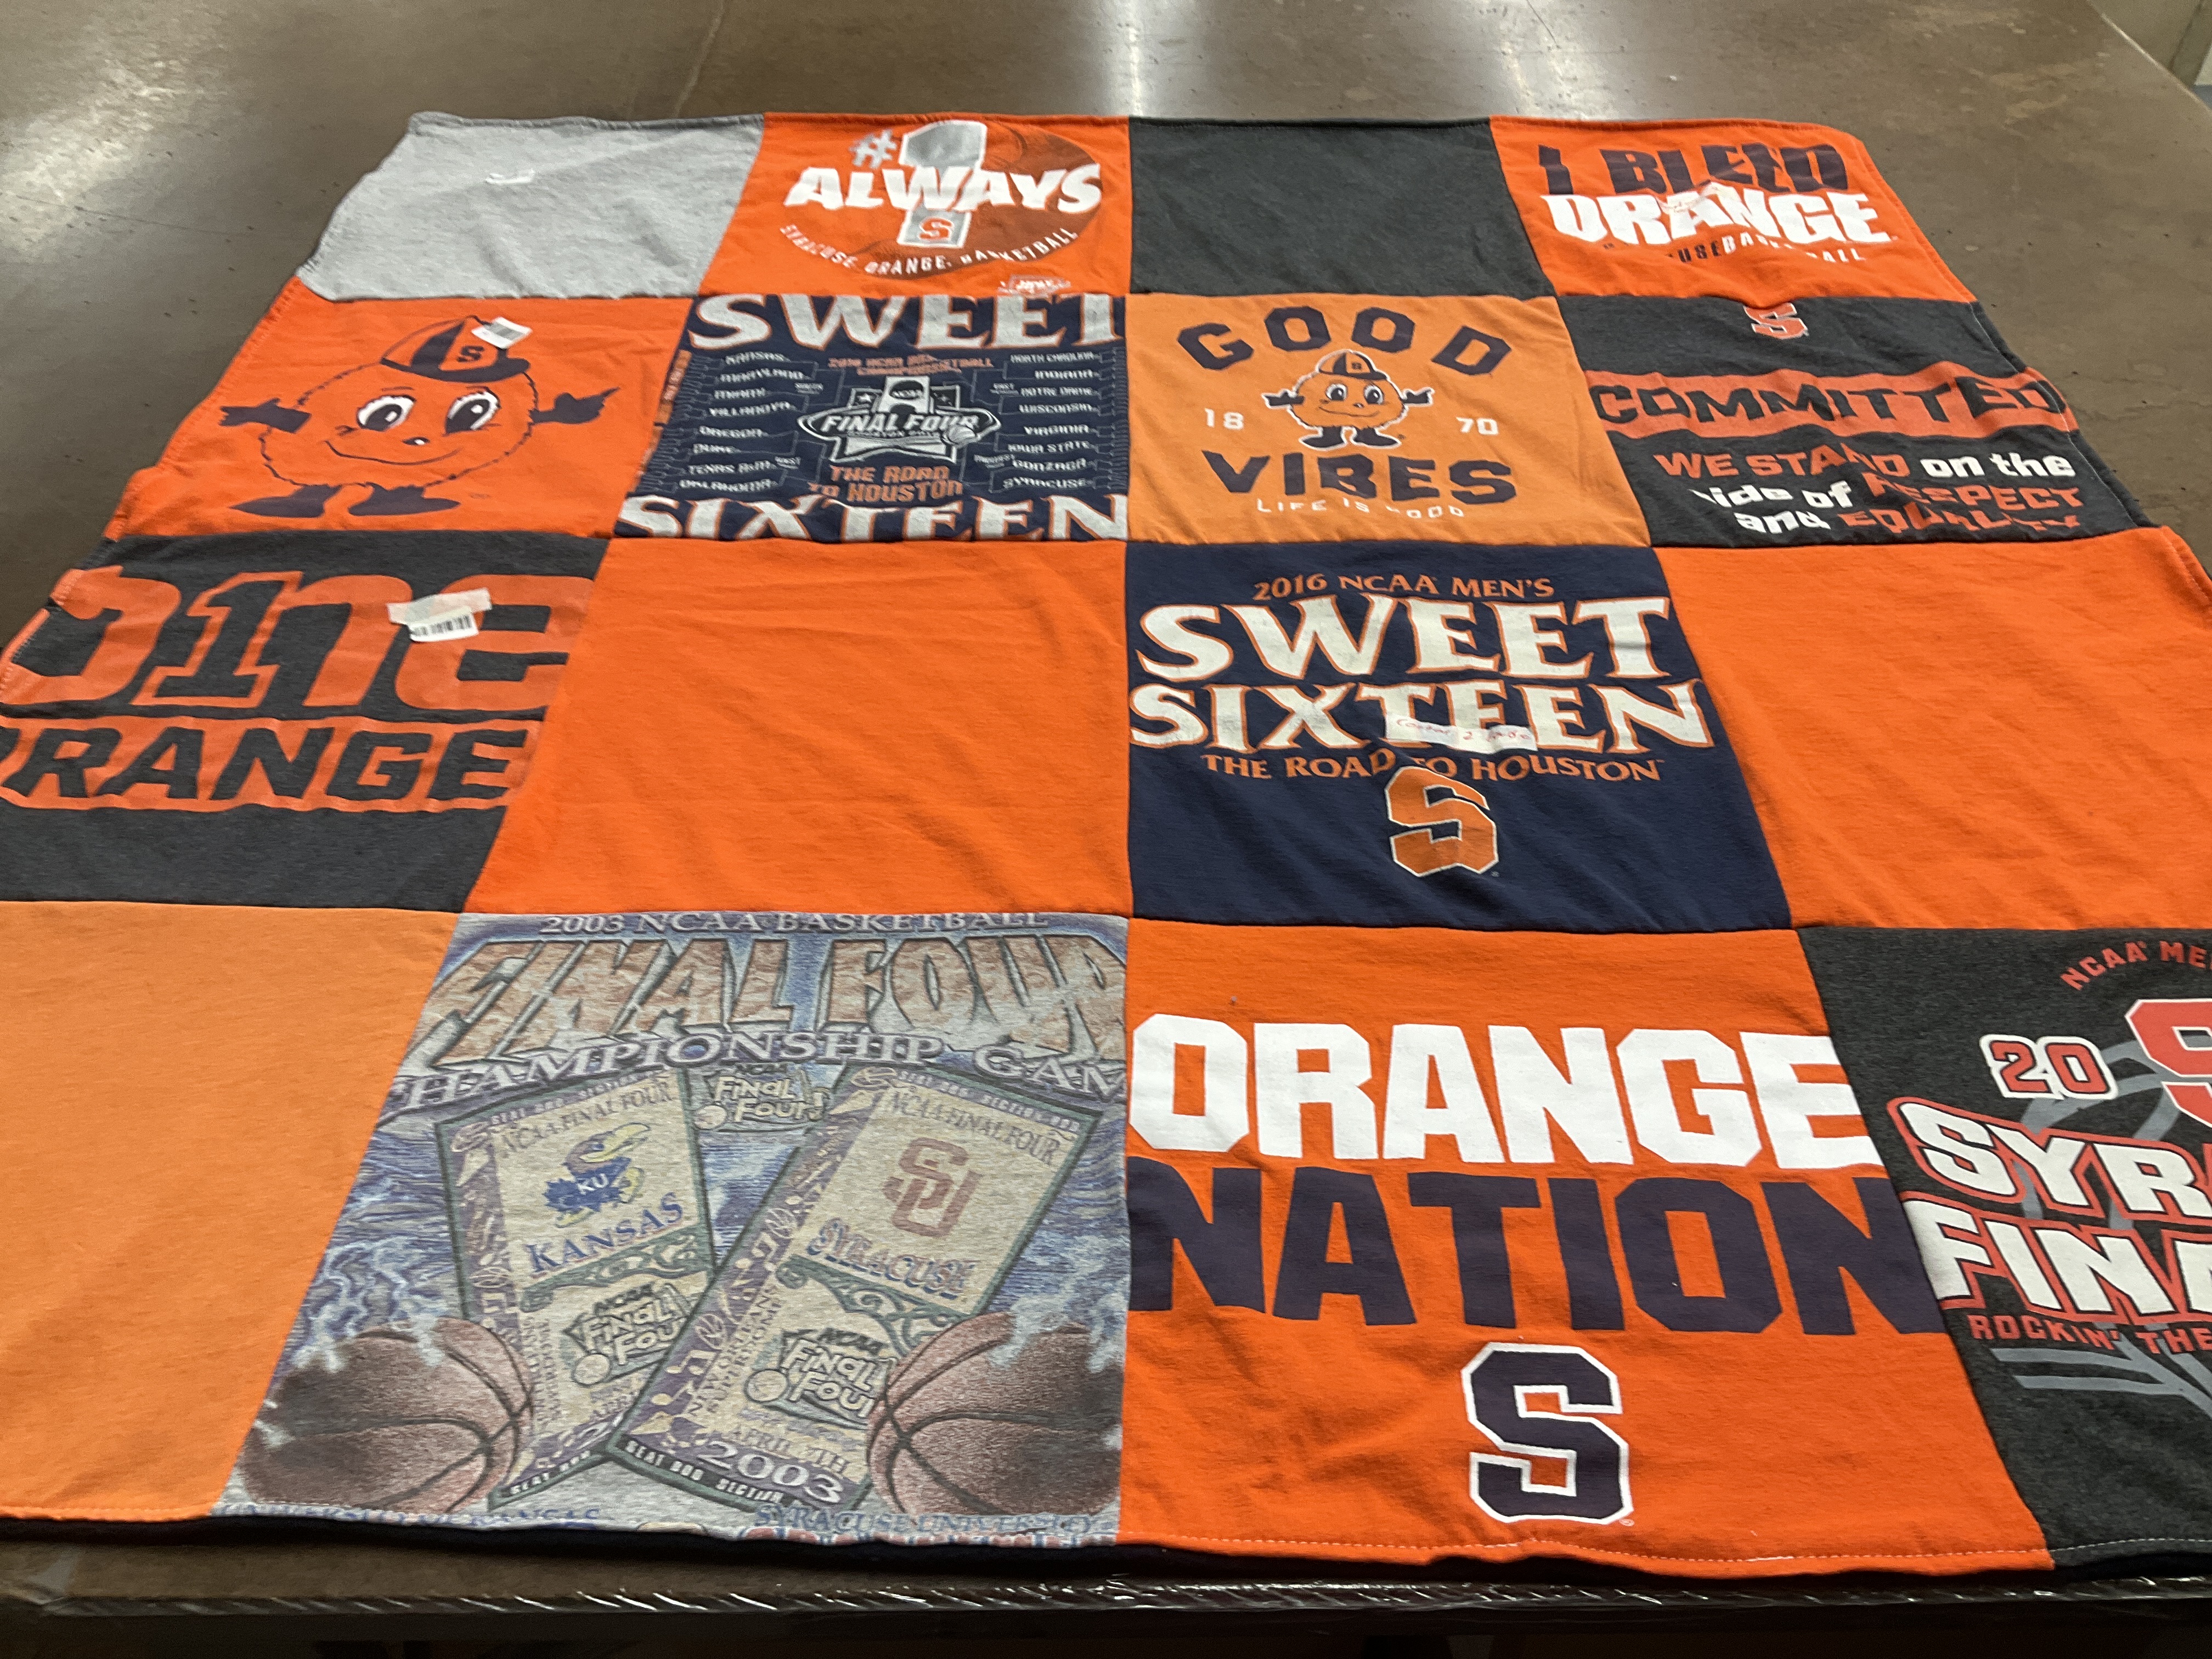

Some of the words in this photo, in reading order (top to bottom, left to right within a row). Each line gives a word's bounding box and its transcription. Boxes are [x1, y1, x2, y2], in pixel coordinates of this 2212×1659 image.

[784, 163, 1103, 213] ALWAYS
[1538, 144, 1573, 195] I
[1599, 143, 1848, 193] BLEED
[1540, 190, 1892, 245] ORANGE
[687, 294, 1124, 350] SWEET
[1177, 306, 1512, 376] GOOD
[821, 413, 899, 432] FINAL
[904, 413, 979, 432] FOUR
[1204, 408, 1244, 430] 18
[1594, 375, 2067, 423] COMMITTED
[1456, 416, 1498, 436] 70
[830, 465, 876, 482] THE
[883, 466, 950, 483] ROAD
[1201, 449, 1517, 505] VIBES
[1653, 452, 1739, 478] WE
[1745, 443, 1911, 477] STAND
[1920, 456, 1985, 478] on
[1988, 452, 2075, 477] the
[808, 482, 840, 497] TO
[847, 479, 963, 502] HOUSTON
[1257, 498, 1327, 513] LIFE
[1343, 497, 1370, 513] IS
[1802, 481, 1853, 508] of
[614, 493, 1129, 541] SIXTEEN
[1253, 575, 1328, 601] 2016
[1338, 574, 1439, 595] NCAA
[1452, 577, 1555, 599] MEN'S
[1135, 593, 1671, 681] SWEET
[1128, 677, 1715, 755] SIXTEEN
[0, 727, 529, 800] RANGE
[1201, 754, 1272, 779] THE
[1285, 748, 1397, 778] ROAD
[1471, 754, 1662, 782] HOUSTON
[1384, 765, 1500, 878] S
[539, 915, 624, 934] 2003
[628, 912, 761, 933] NCAA
[776, 912, 1049, 932] BASKETBALL
[2061, 940, 2148, 991] NCAA
[2159, 940, 2212, 971] ME
[404, 937, 794, 1068] FINAL
[826, 935, 1126, 1060] FOUR
[1128, 1014, 1886, 1170] ORANGE
[1979, 1034, 2118, 1099] 20
[575, 1173, 608, 1195] KU
[525, 1192, 684, 1276] KANSAS
[1127, 1155, 1946, 1335] NATION
[1968, 1315, 2120, 1350] ROCKIN'
[2135, 1326, 2212, 1355] THE
[1460, 1342, 1633, 1523] S
[698, 1440, 845, 1504] 2003
